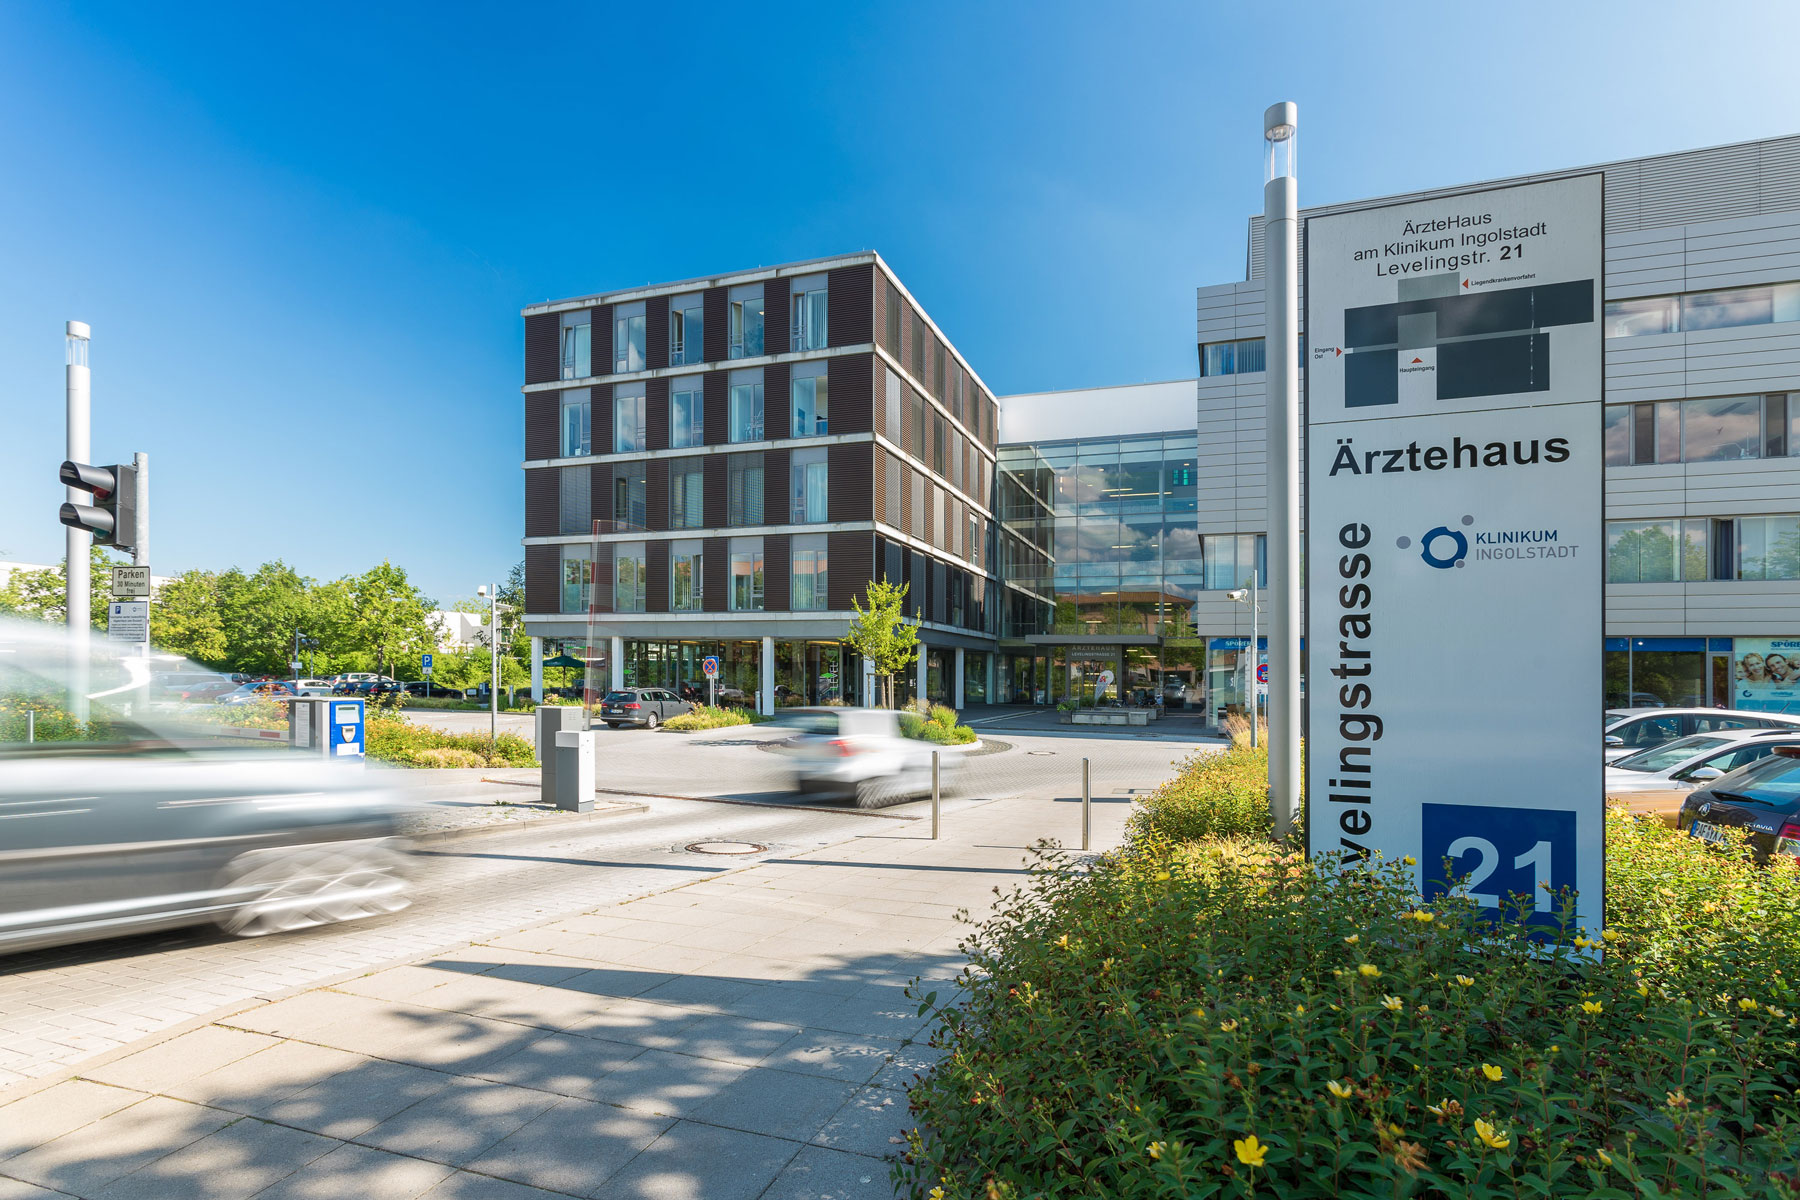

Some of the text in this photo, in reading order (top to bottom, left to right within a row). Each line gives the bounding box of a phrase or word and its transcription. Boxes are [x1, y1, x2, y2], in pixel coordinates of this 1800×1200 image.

[1402, 213, 1492, 236] ÄrzteHaus
[1353, 222, 1547, 262] am Klinikum Ingolstadt
[1377, 243, 1523, 277] Levelingstr. 21
[1470, 273, 1536, 287] Liegendkrankenvorfahrt
[1399, 365, 1435, 374] Haupteingang
[1328, 436, 1571, 477] Ärztehaus
[1475, 529, 1558, 545] KLINIKUM
[1475, 545, 1580, 561] INGOLSTADT
[117, 569, 145, 579] Parken
[116, 580, 146, 588] 30 Minuten
[1329, 522, 1384, 882] velingstrasse
[1446, 835, 1552, 913] 21
